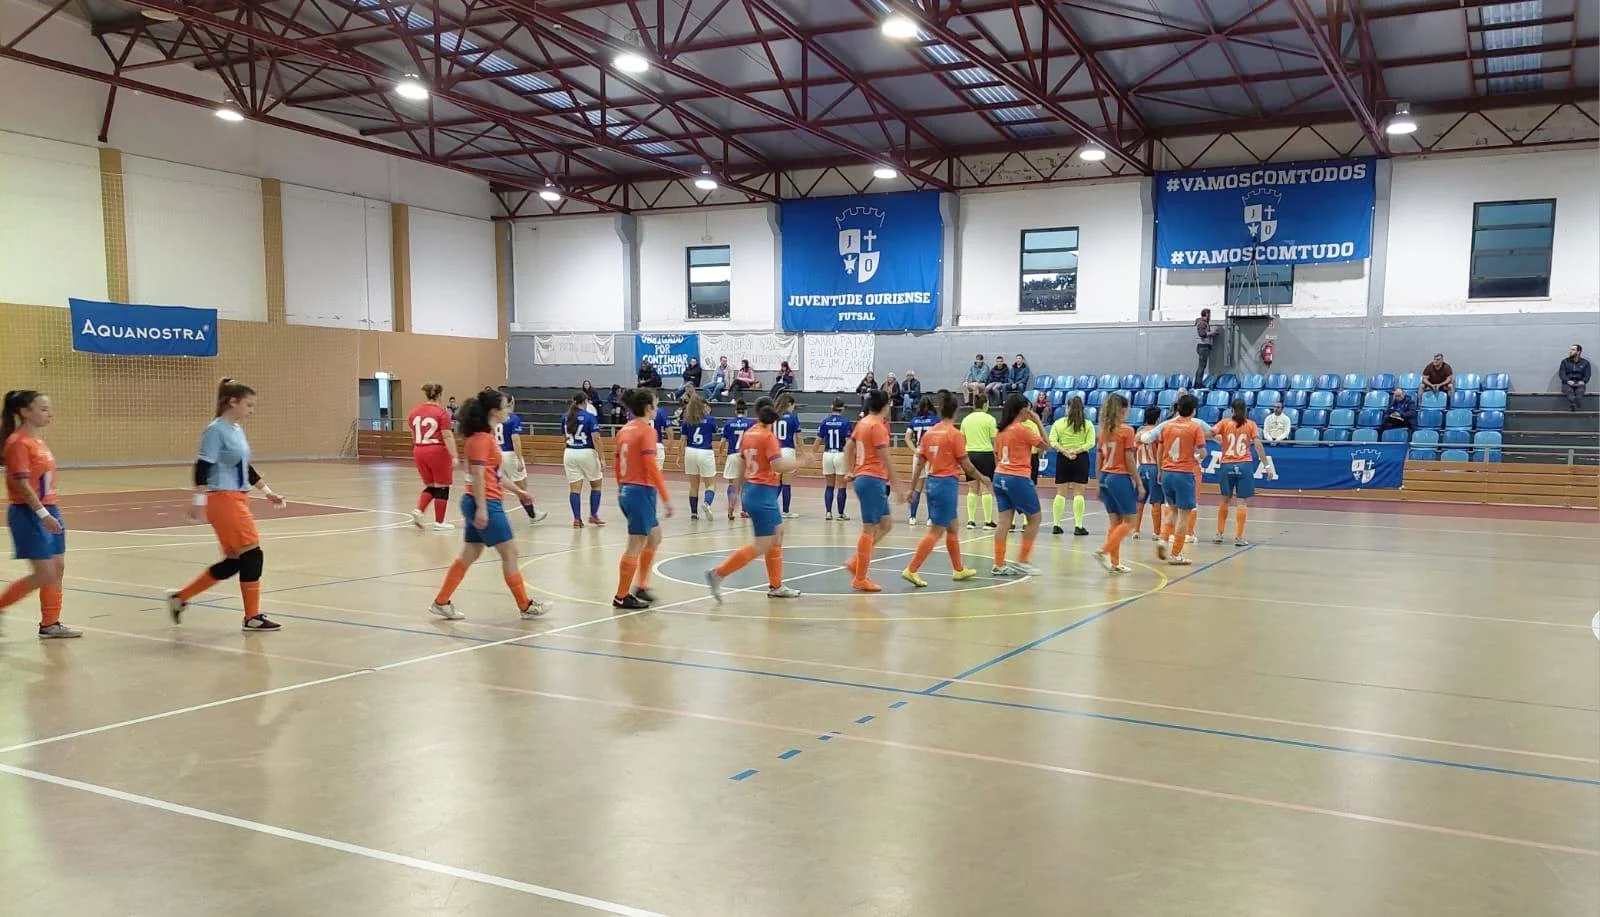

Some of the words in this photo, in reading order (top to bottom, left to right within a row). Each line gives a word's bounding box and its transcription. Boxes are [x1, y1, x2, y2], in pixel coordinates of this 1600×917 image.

[1166, 163, 1367, 192] #VAMOSCOMTODOS
[846, 235, 852, 248] J
[1170, 241, 1354, 265] #VAMOSCOMTUDO
[864, 258, 873, 272] O
[788, 293, 863, 307] JUVENTUDE
[865, 292, 931, 306] OURIENSE
[838, 312, 875, 321] FUTSAL
[654, 344, 671, 354] POR
[642, 354, 688, 365] CONTINUAR
[412, 415, 440, 444] 12
[692, 427, 704, 445] 6
[828, 429, 840, 449] 11
[1225, 433, 1248, 457] 26
[1168, 437, 1181, 463] 4
